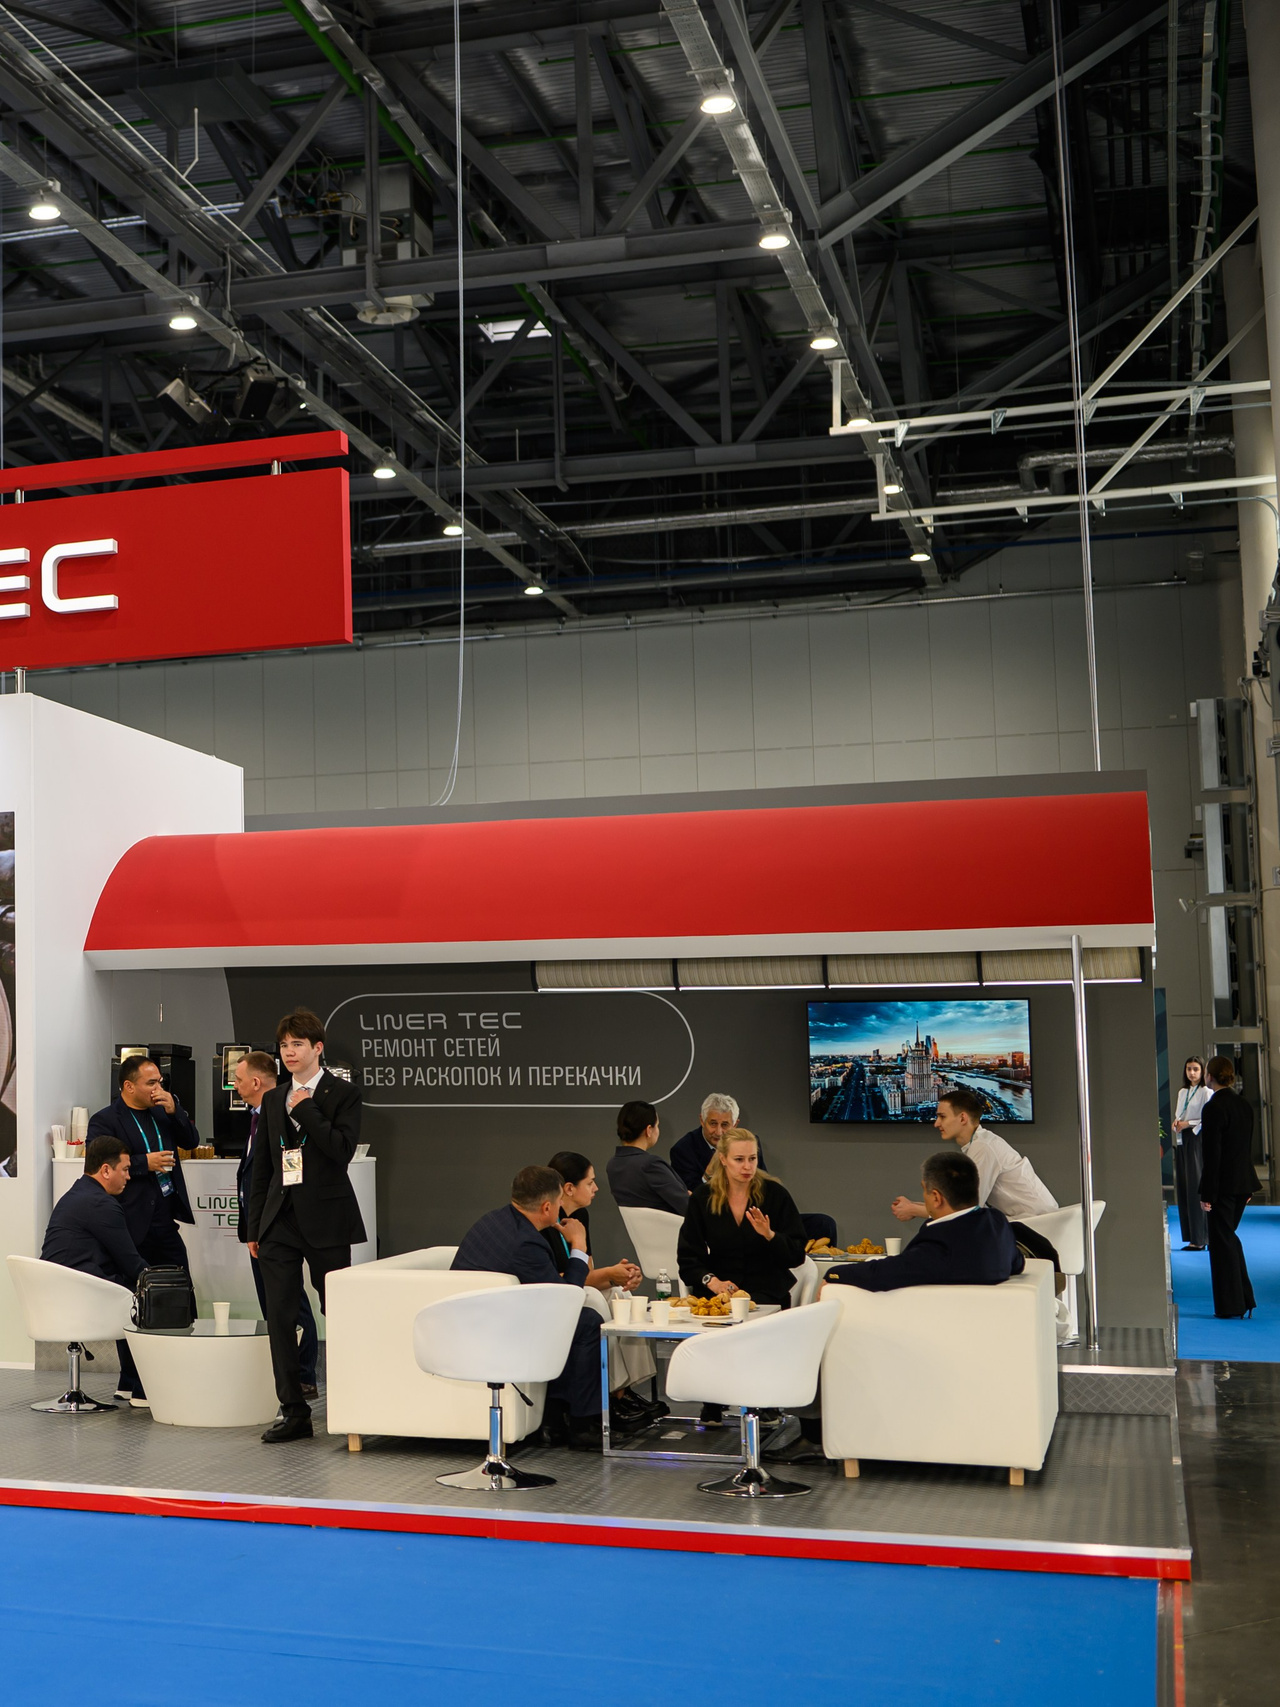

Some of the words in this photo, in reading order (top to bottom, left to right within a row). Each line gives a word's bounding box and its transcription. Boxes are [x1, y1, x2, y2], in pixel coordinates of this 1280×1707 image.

[359, 1013, 447, 1031] LINER
[458, 1012, 522, 1029] TEC
[362, 1038, 437, 1058] РЕМОНТ
[443, 1033, 500, 1057] СЕТЕЙ
[363, 1067, 396, 1086] БЕЗ
[402, 1066, 502, 1086] РАСКОПОК
[508, 1066, 521, 1085] И
[528, 1066, 641, 1086] ПЕРЕКАЧКИ
[197, 1197, 239, 1209] LINE
[213, 1214, 239, 1226] TE
